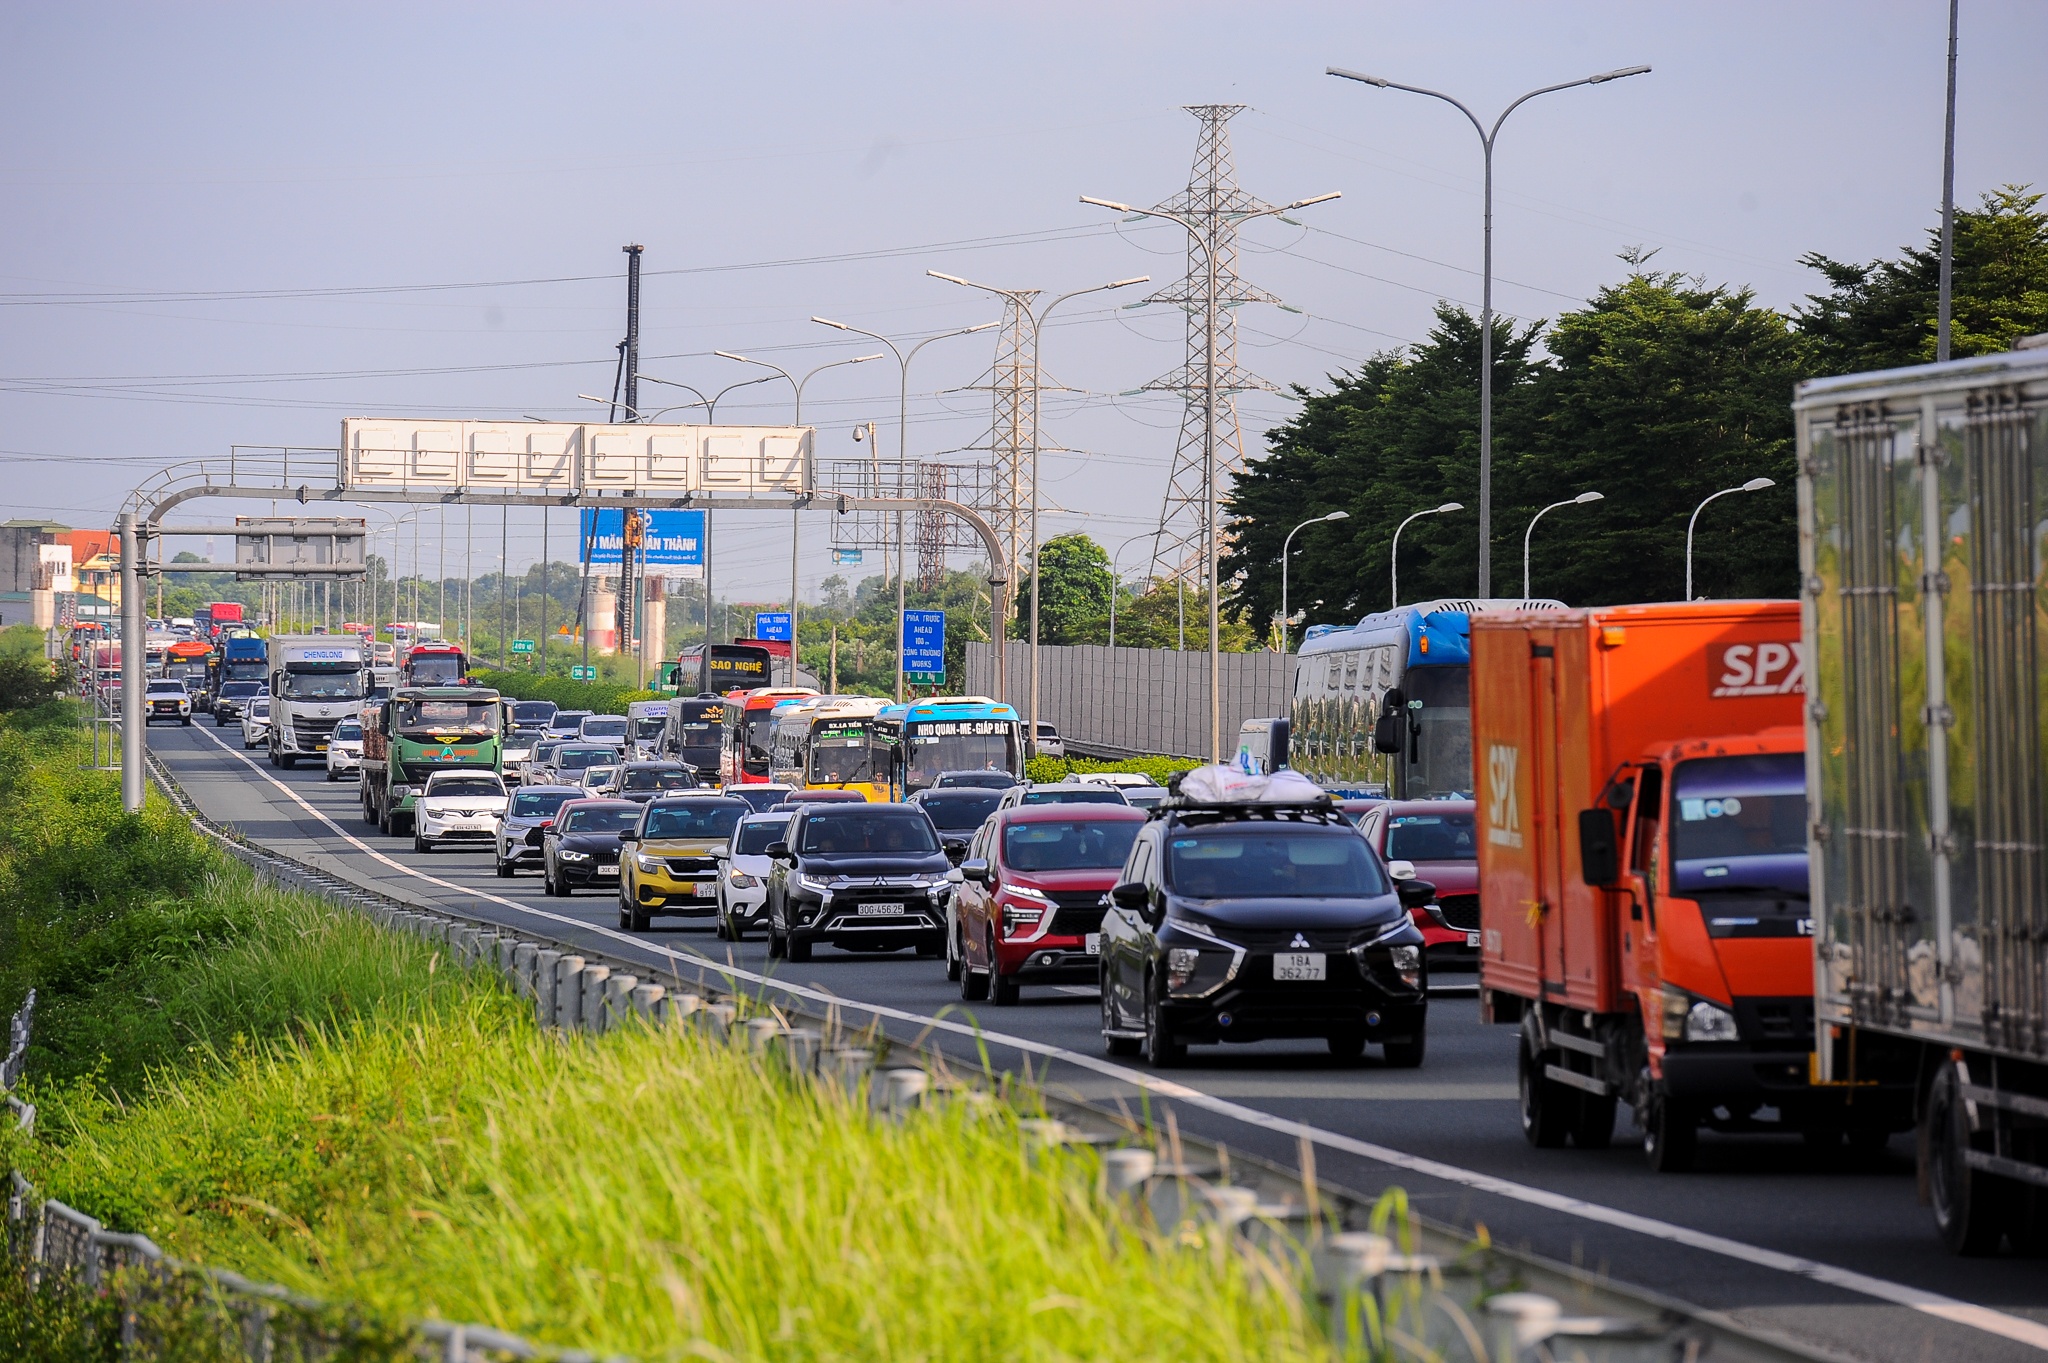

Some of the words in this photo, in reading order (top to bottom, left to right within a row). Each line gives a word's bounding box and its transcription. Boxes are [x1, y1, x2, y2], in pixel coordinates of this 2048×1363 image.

[599, 534, 623, 549] MĂN
[663, 535, 697, 551] THÀNH
[914, 626, 933, 634] AHEAD
[915, 637, 925, 645] 100
[304, 651, 343, 659] CHENGLONG
[710, 660, 732, 670] SAO
[735, 661, 762, 673] NGHỆ
[912, 660, 932, 668] WORKS
[917, 724, 934, 736] NHO
[994, 720, 1009, 735] BÁT
[1489, 745, 1518, 829] SPX
[859, 905, 903, 914] 30G-456.25
[1291, 955, 1311, 966] 18A
[1280, 967, 1320, 979] 362.77
